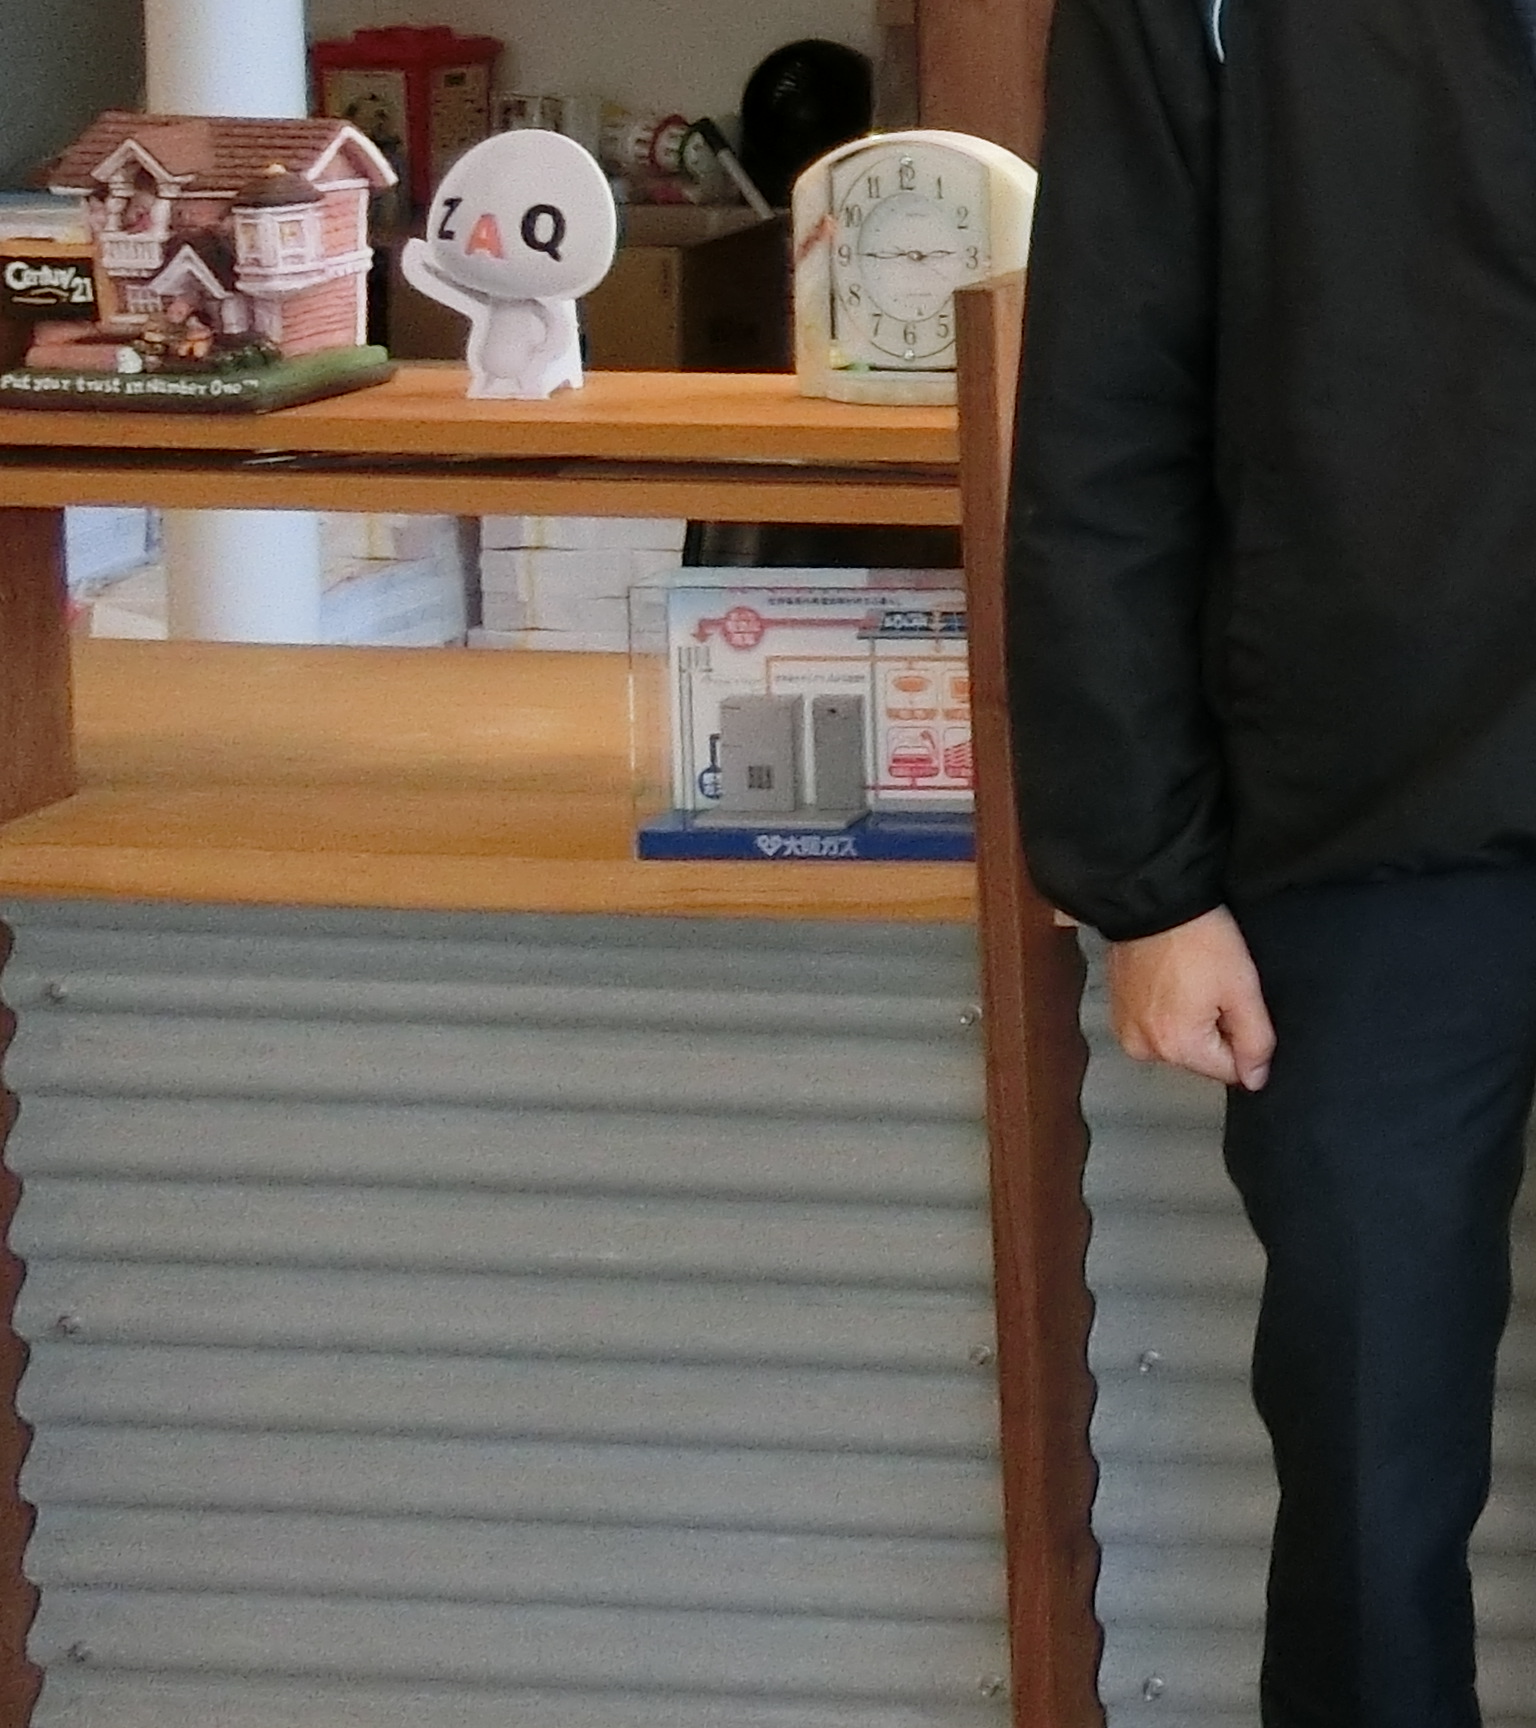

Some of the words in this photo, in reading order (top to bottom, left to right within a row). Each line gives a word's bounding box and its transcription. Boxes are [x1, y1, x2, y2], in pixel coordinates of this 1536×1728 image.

[936, 176, 944, 199] 1
[437, 196, 567, 262] ZAQ
[957, 205, 969, 229] 2
[838, 244, 852, 267] 9
[966, 246, 979, 270] 3
[70, 276, 94, 303] 21
[848, 283, 861, 307] 8
[872, 313, 882, 337] 7
[903, 322, 916, 346] 6
[937, 314, 949, 338] 5
